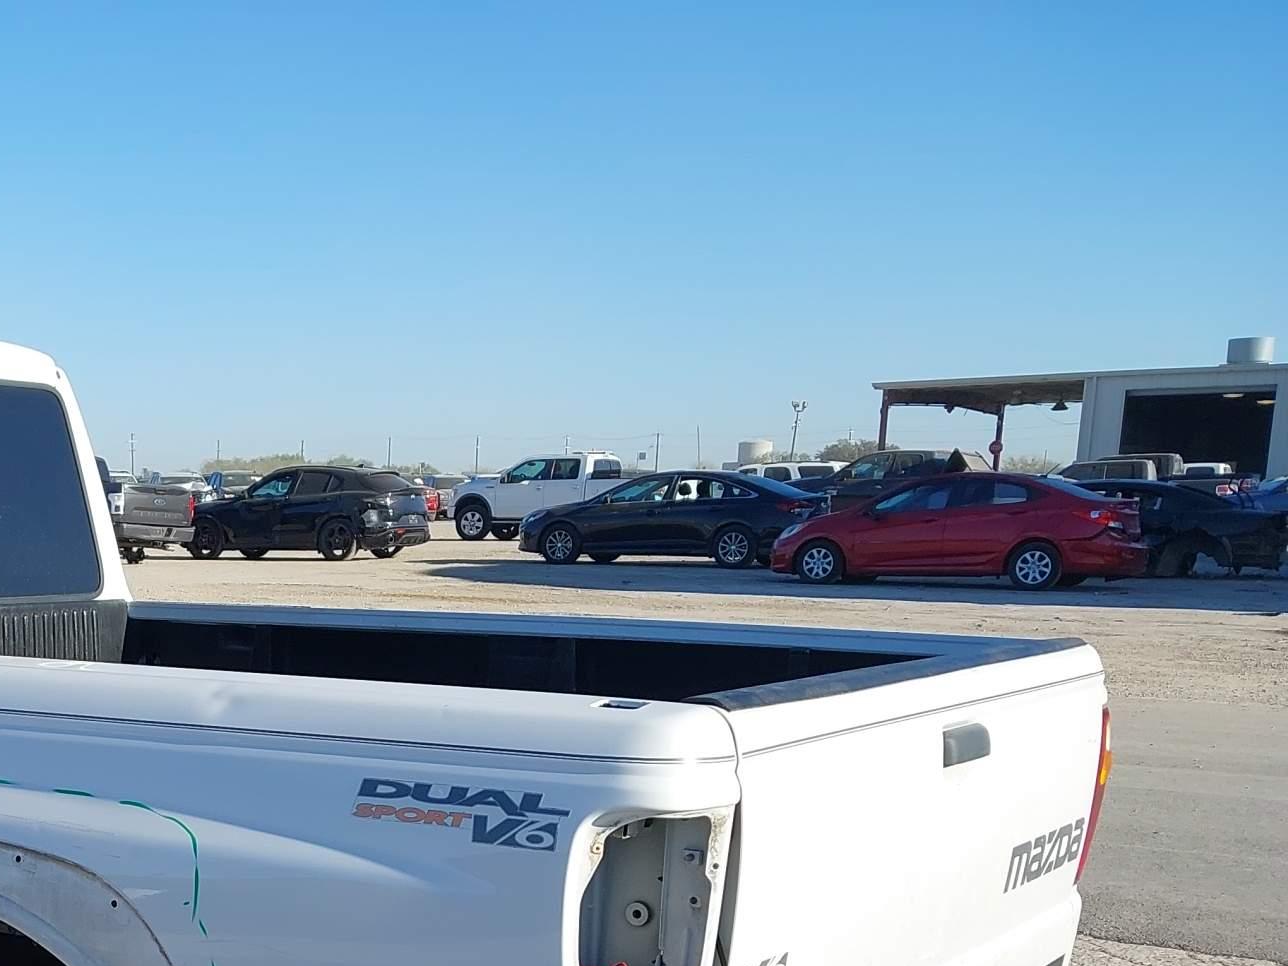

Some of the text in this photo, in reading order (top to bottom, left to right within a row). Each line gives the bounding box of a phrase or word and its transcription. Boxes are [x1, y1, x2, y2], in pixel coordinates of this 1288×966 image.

[353, 803, 472, 828] SPORT
[357, 778, 571, 817] DUAL
[472, 814, 560, 851] V6
